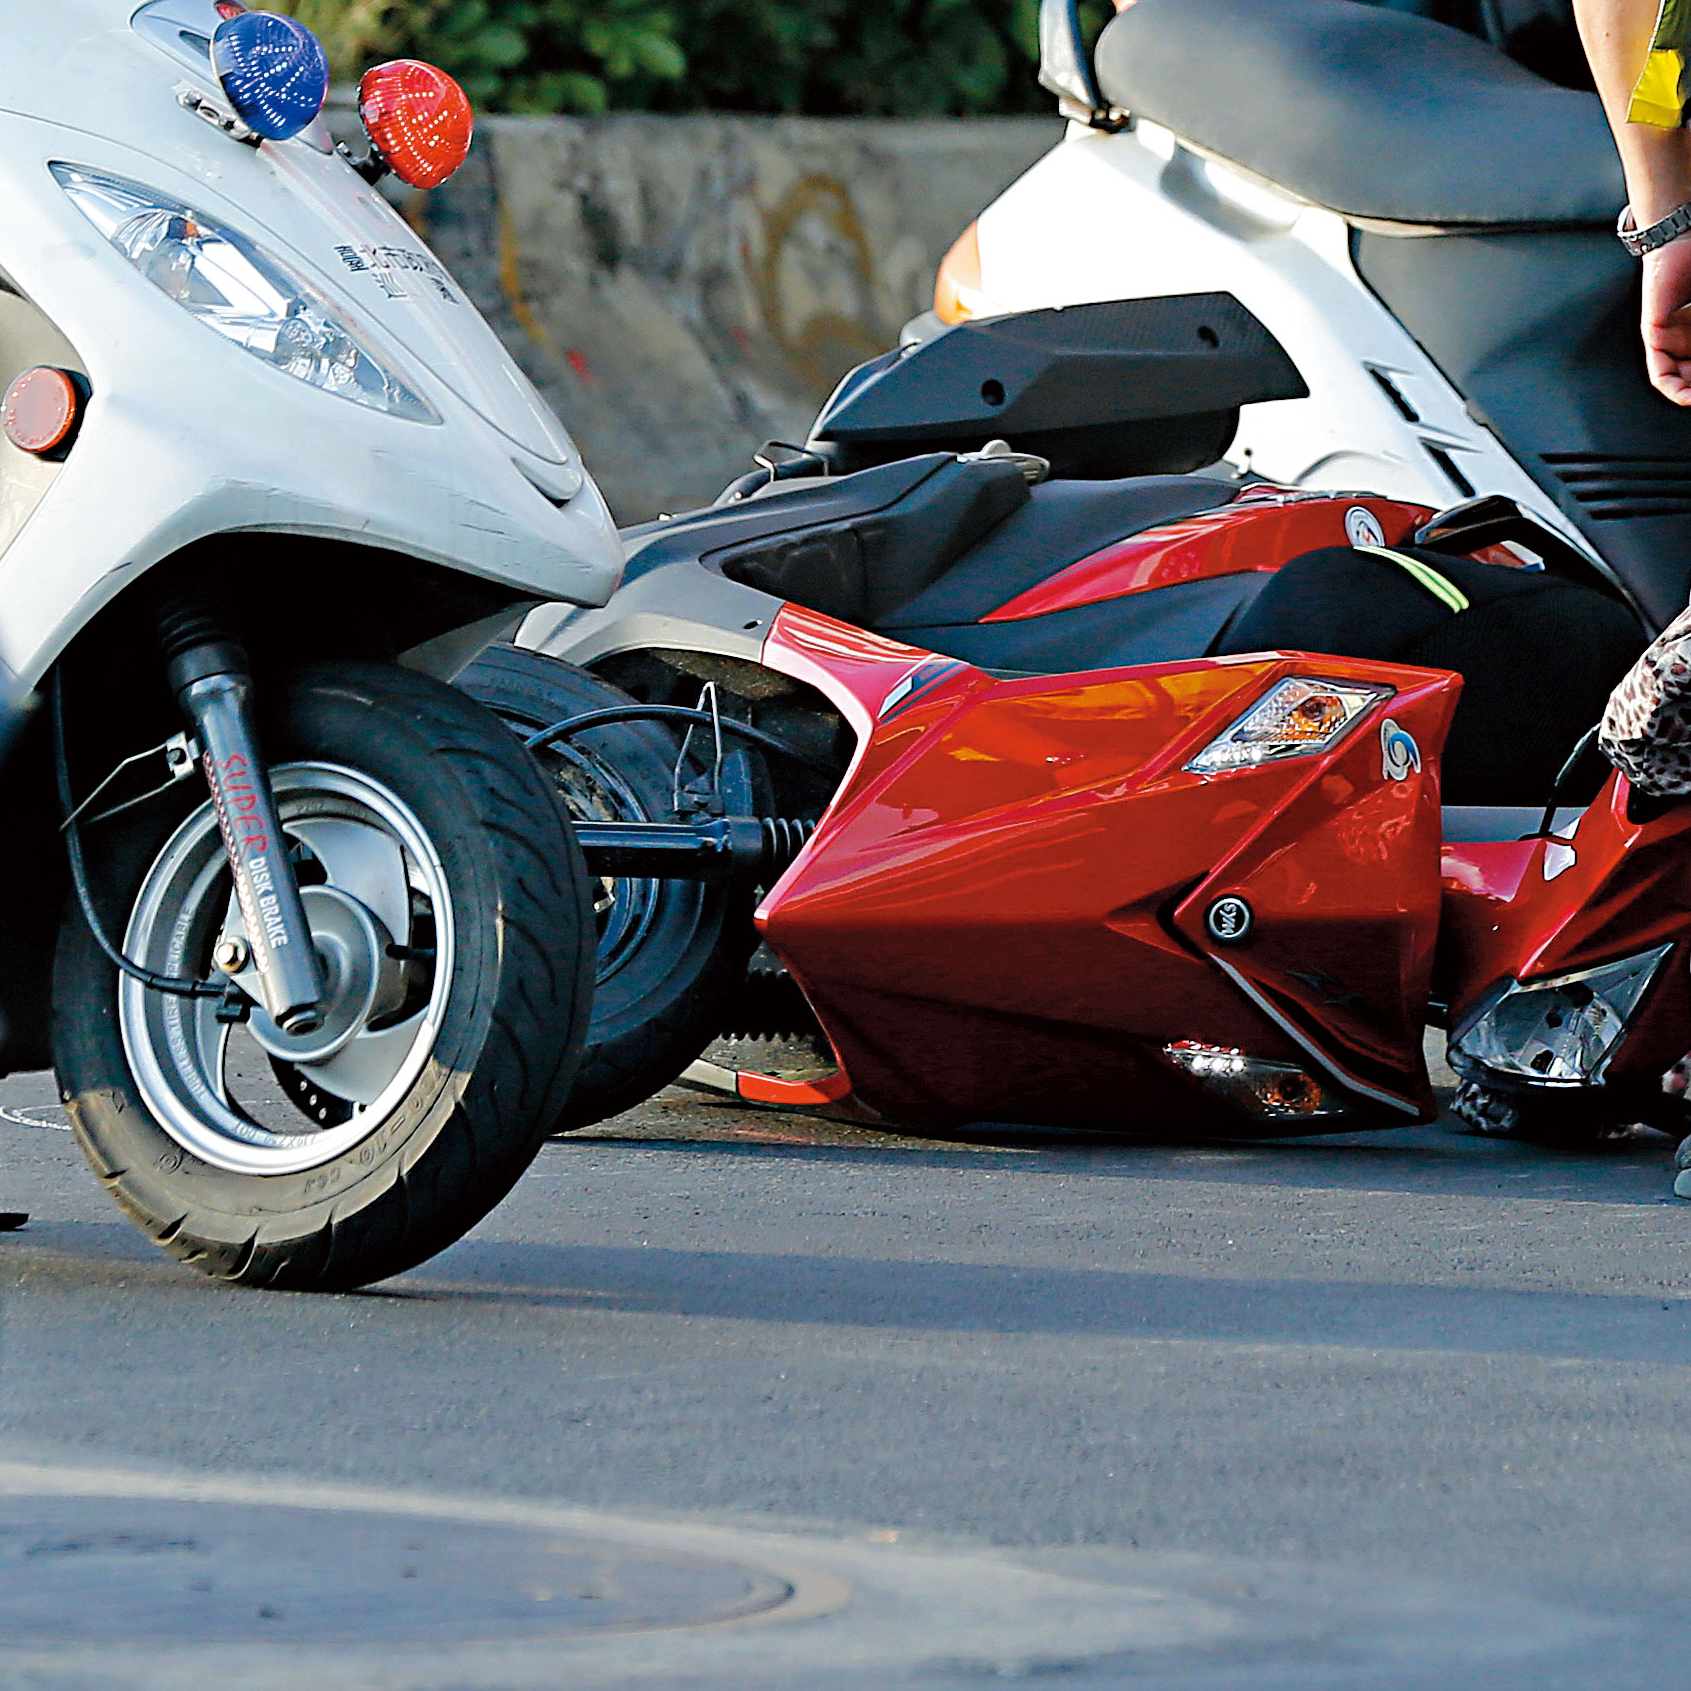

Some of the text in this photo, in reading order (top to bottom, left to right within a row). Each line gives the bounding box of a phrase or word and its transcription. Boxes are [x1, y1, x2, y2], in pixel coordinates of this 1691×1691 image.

[216, 754, 268, 857] SUPER
[249, 856, 288, 949] DISK BRAKE
[1219, 902, 1238, 934] SYM
